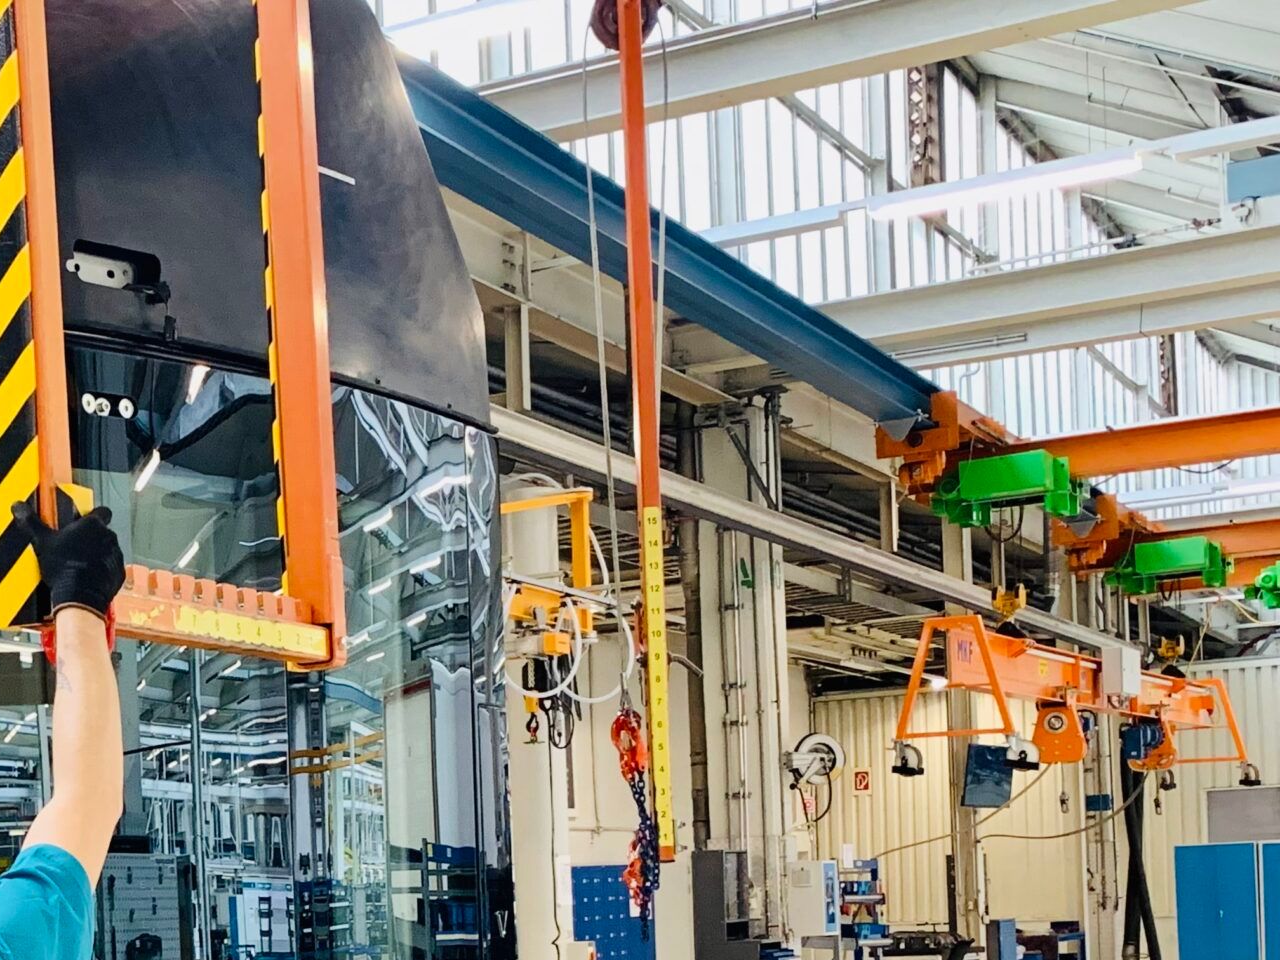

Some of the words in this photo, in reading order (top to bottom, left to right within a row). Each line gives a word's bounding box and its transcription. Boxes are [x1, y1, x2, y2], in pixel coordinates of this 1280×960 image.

[647, 517, 657, 525] 15
[649, 562, 659, 570] 13
[655, 675, 661, 683] 8
[658, 743, 664, 751] 5
